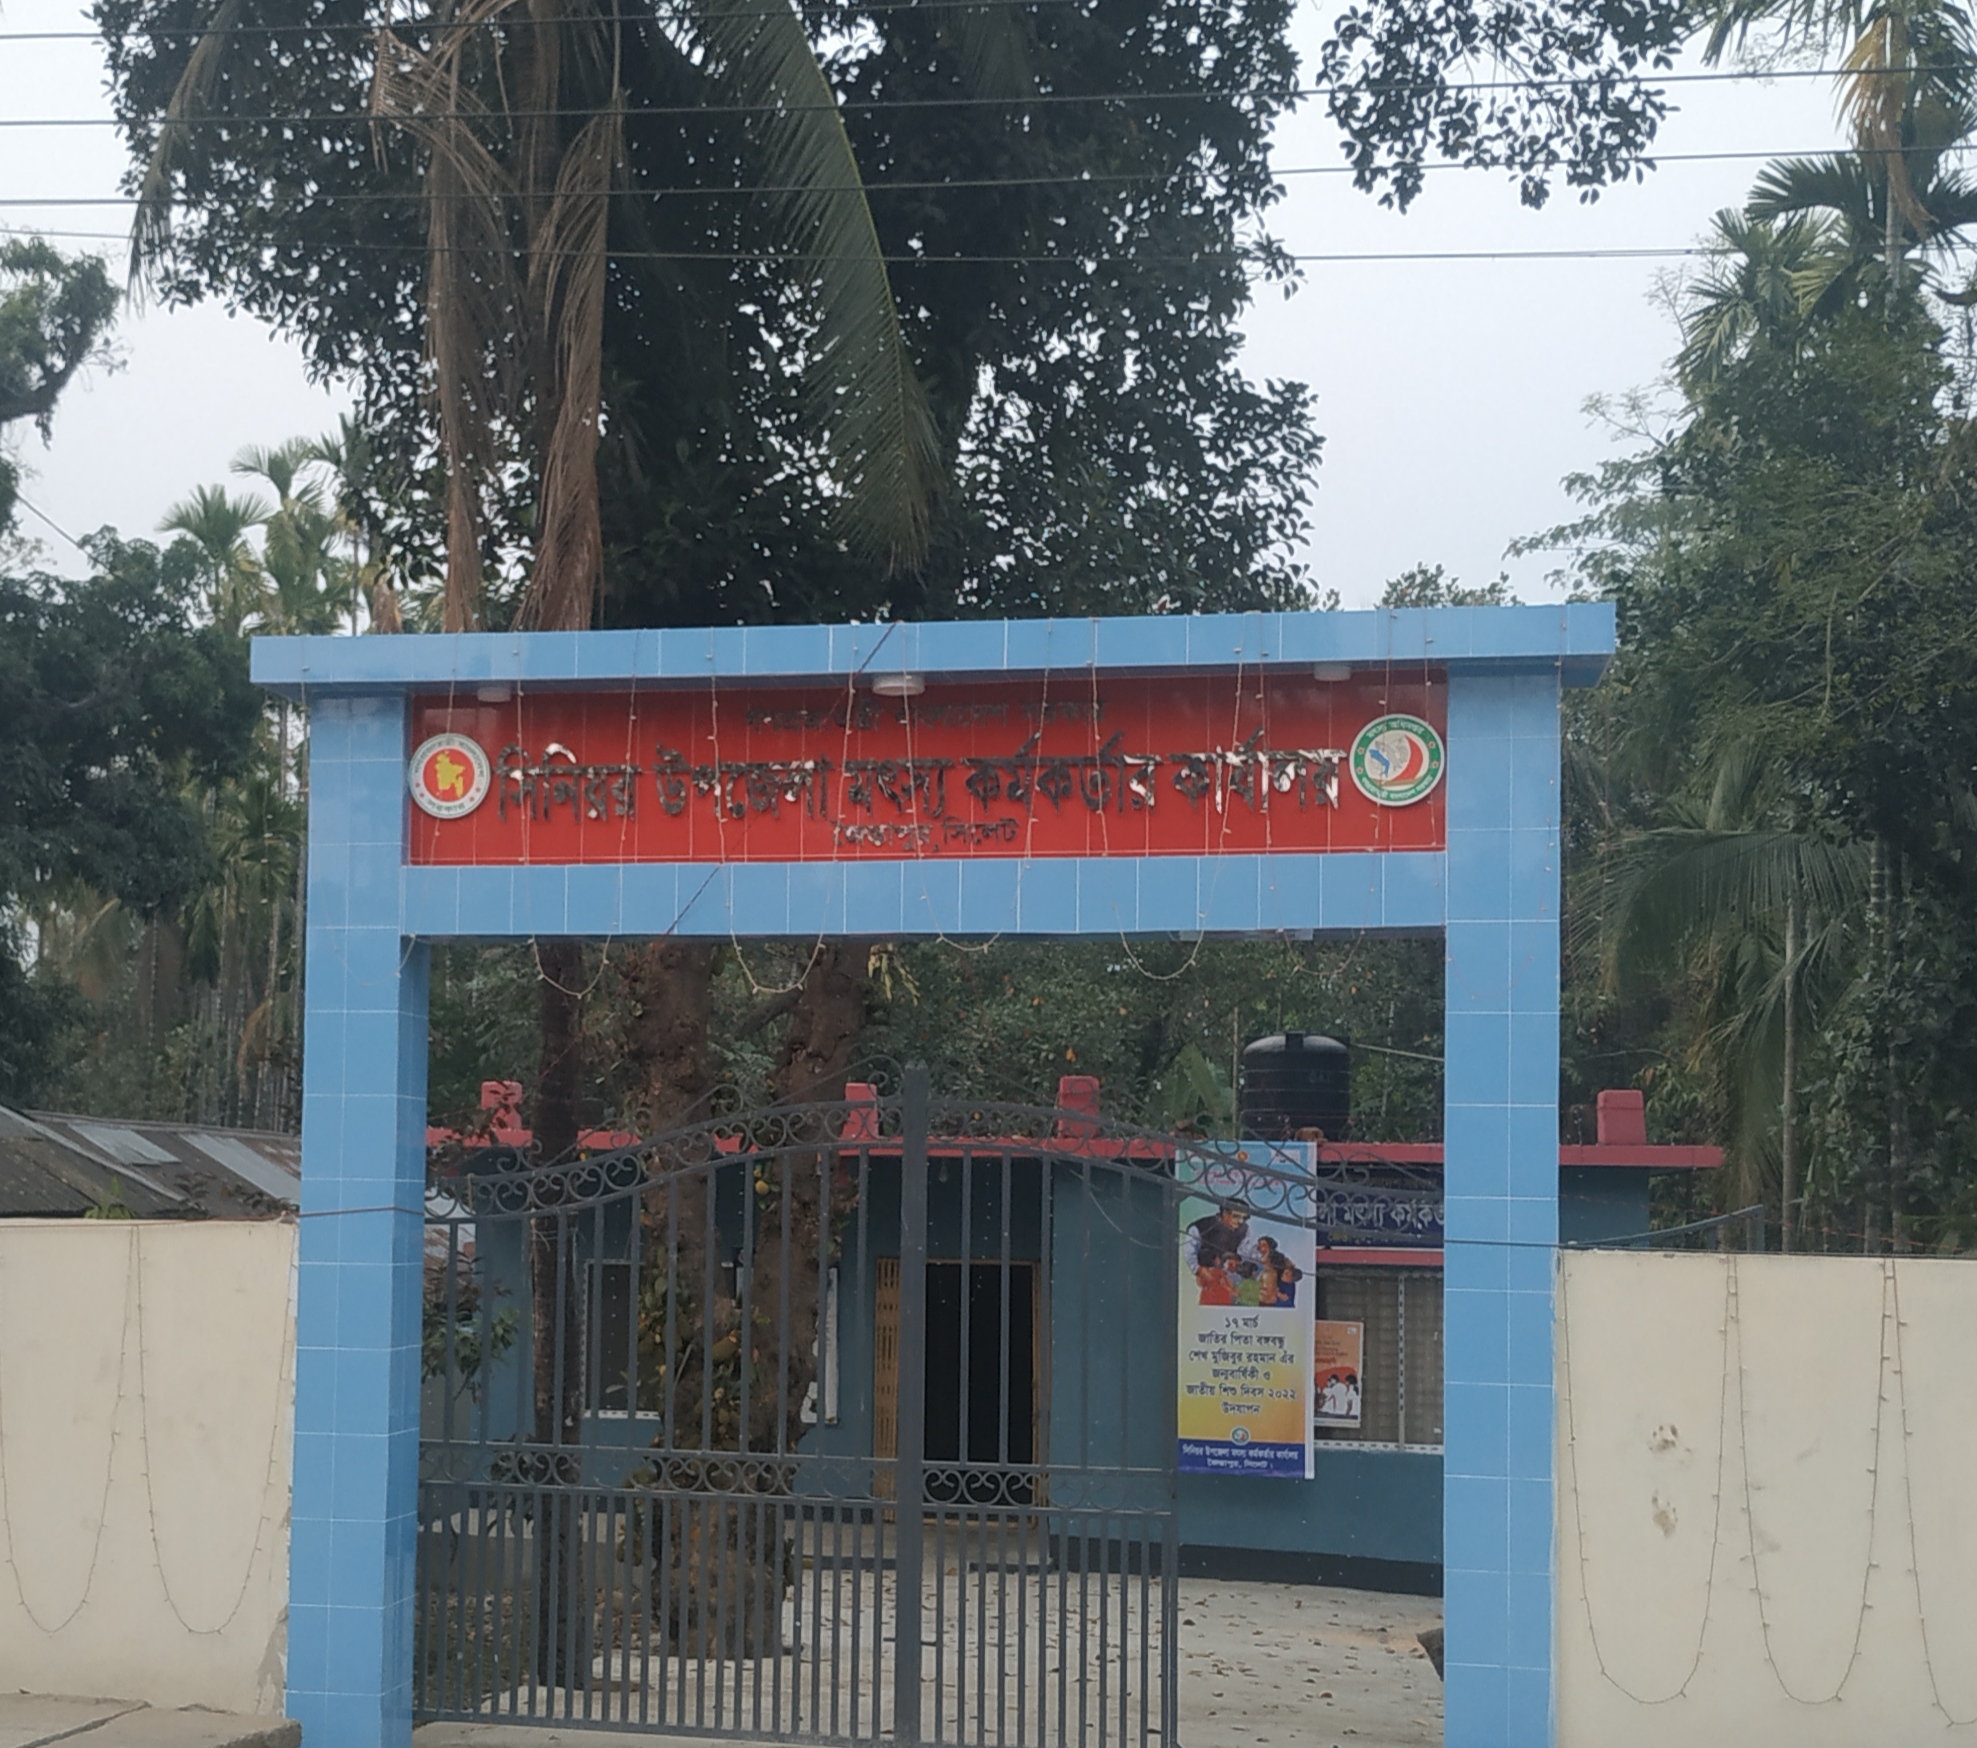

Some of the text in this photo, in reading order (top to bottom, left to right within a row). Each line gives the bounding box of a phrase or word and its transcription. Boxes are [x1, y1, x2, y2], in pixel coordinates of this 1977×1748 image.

[496, 743, 641, 822] সিনিয়র
[651, 742, 834, 819] উপজেলা
[842, 757, 954, 817] মৎস্য
[961, 729, 1162, 814] কর্মকর্তার
[1168, 726, 1347, 812] কার্যালয়
[941, 816, 1020, 845] সিলেট
[1225, 1314, 1259, 1329] ১৭ মার্চ
[1198, 1330, 1227, 1344] জাতির
[1230, 1331, 1253, 1345] পিতা
[1189, 1350, 1208, 1361] শেখ
[1211, 1348, 1243, 1364] মুজিবুর
[1246, 1352, 1276, 1363] রহমান
[1263, 1371, 1270, 1380] ও
[1186, 1381, 1215, 1395] জাতীয়
[1240, 1383, 1264, 1397] দিবস
[1268, 1388, 1296, 1399] ২০২২
